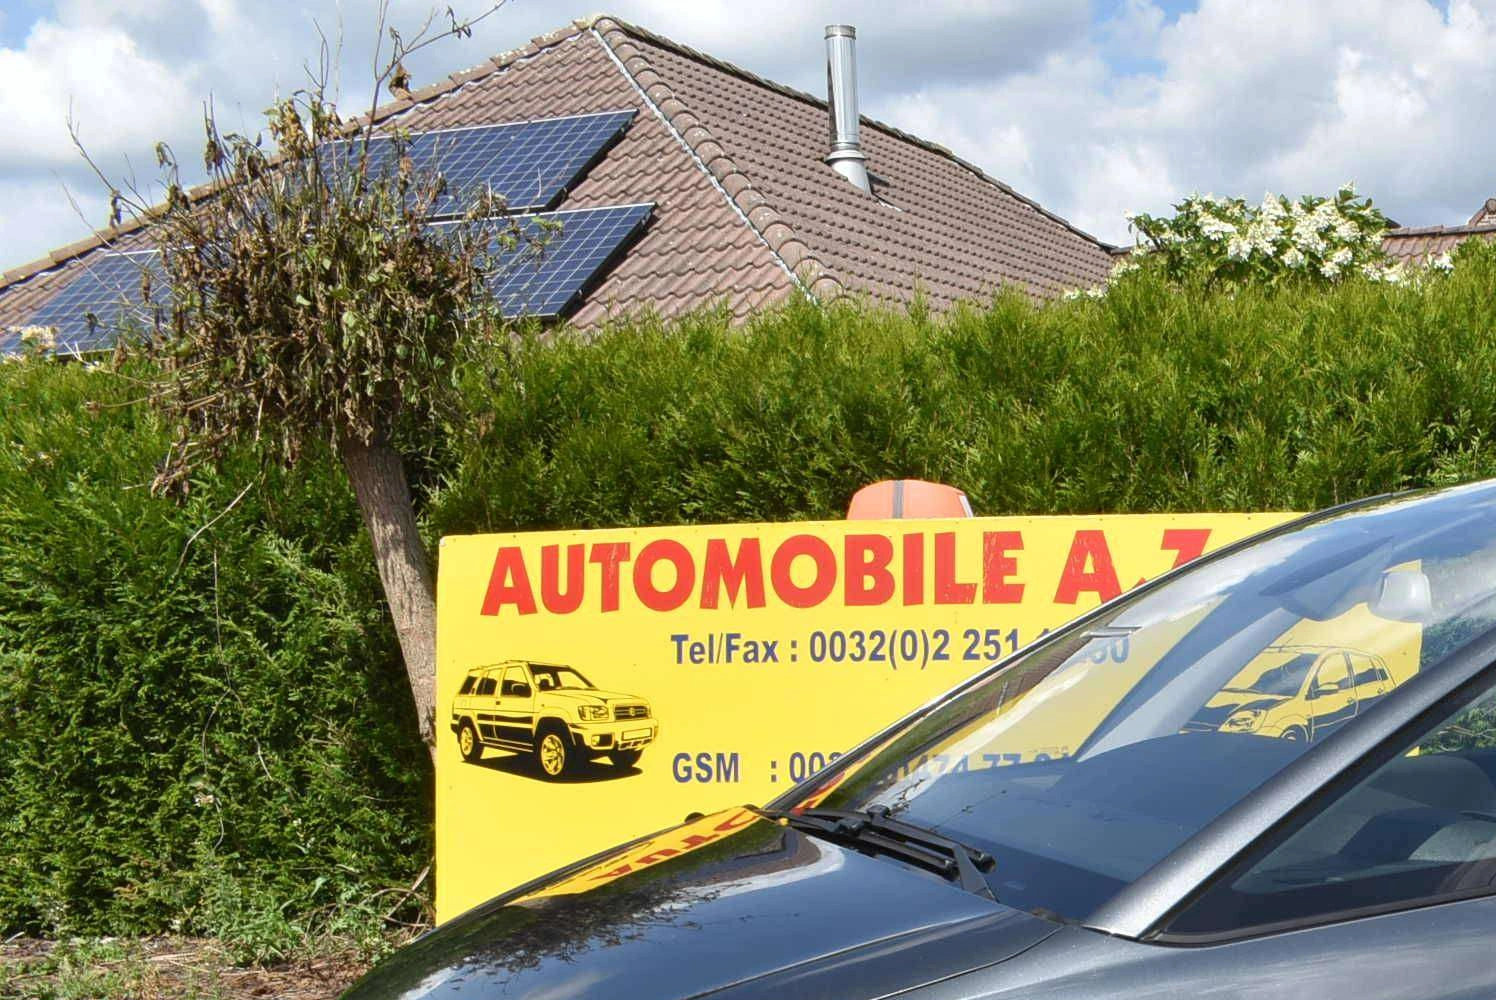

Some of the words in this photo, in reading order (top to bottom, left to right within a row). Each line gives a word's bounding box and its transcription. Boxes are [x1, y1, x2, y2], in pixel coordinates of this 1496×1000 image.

[480, 530, 1026, 617] AUTOMOBILE
[671, 632, 779, 665] Tel/Fax
[809, 628, 951, 671] 0032(0)2
[963, 628, 1019, 661] 251
[672, 752, 740, 784] GSM
